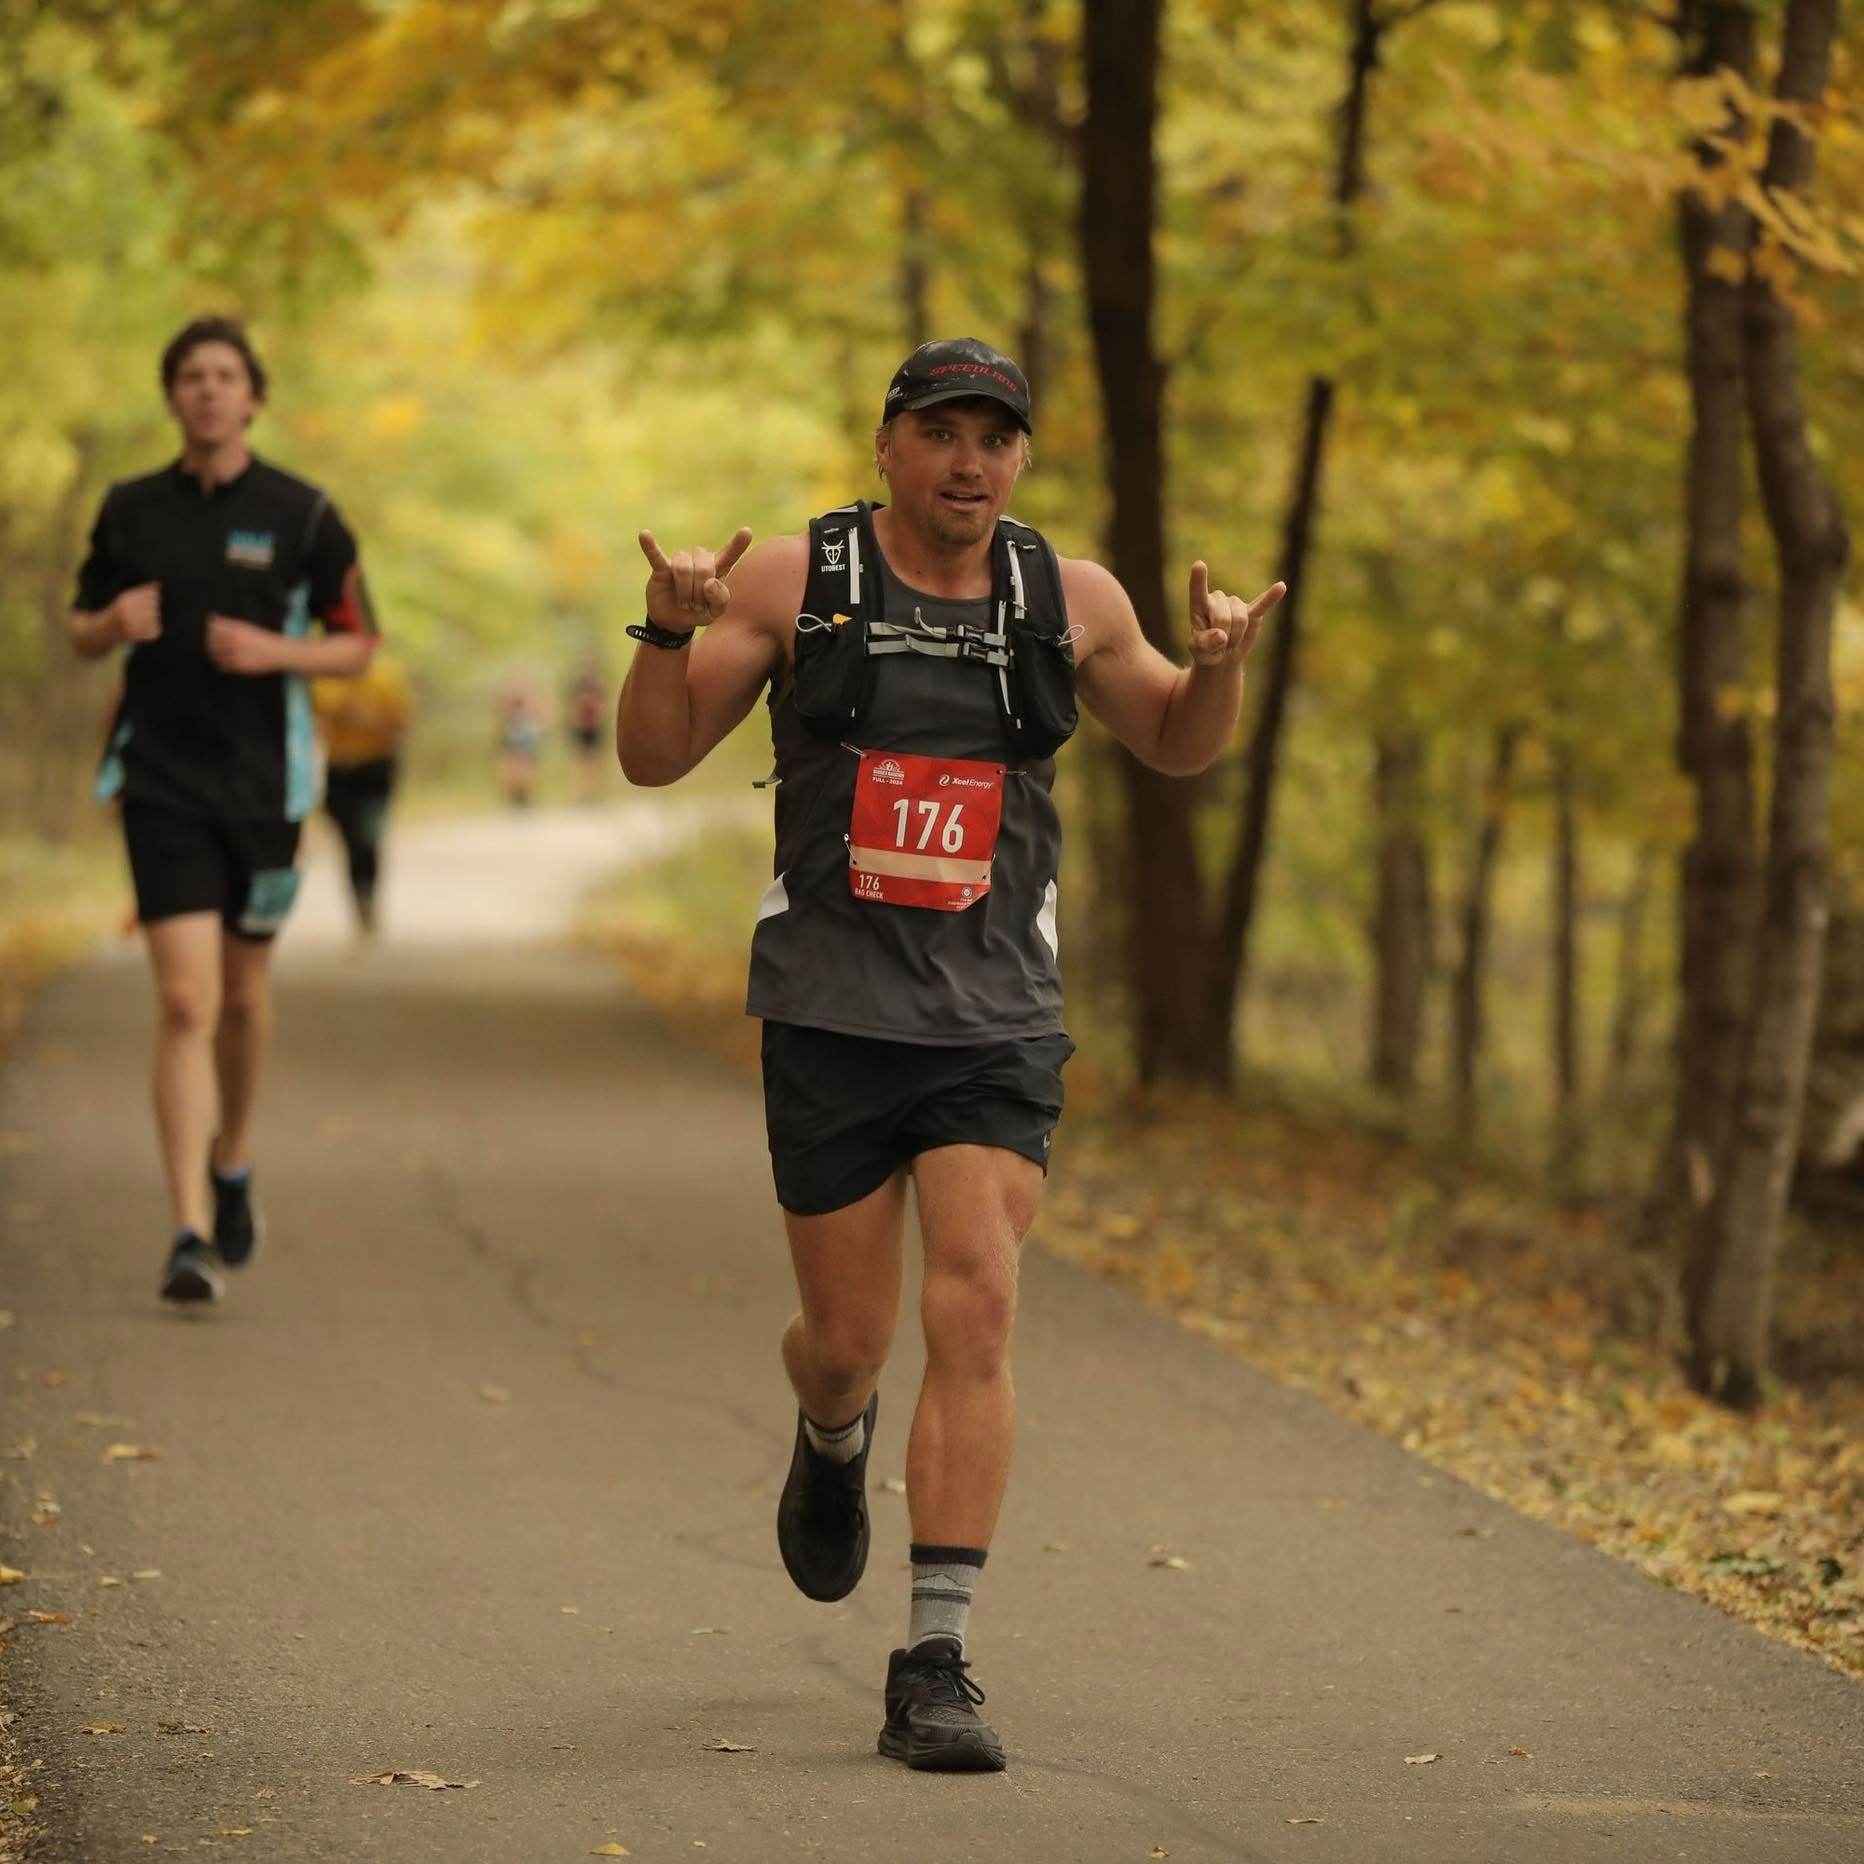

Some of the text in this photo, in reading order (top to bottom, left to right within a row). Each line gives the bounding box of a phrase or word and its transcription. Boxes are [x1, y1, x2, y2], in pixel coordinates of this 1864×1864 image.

[821, 564, 845, 572] UTOBEST
[894, 799, 964, 853] 176
[859, 874, 880, 891] 176
[866, 890, 883, 899] CHECK
